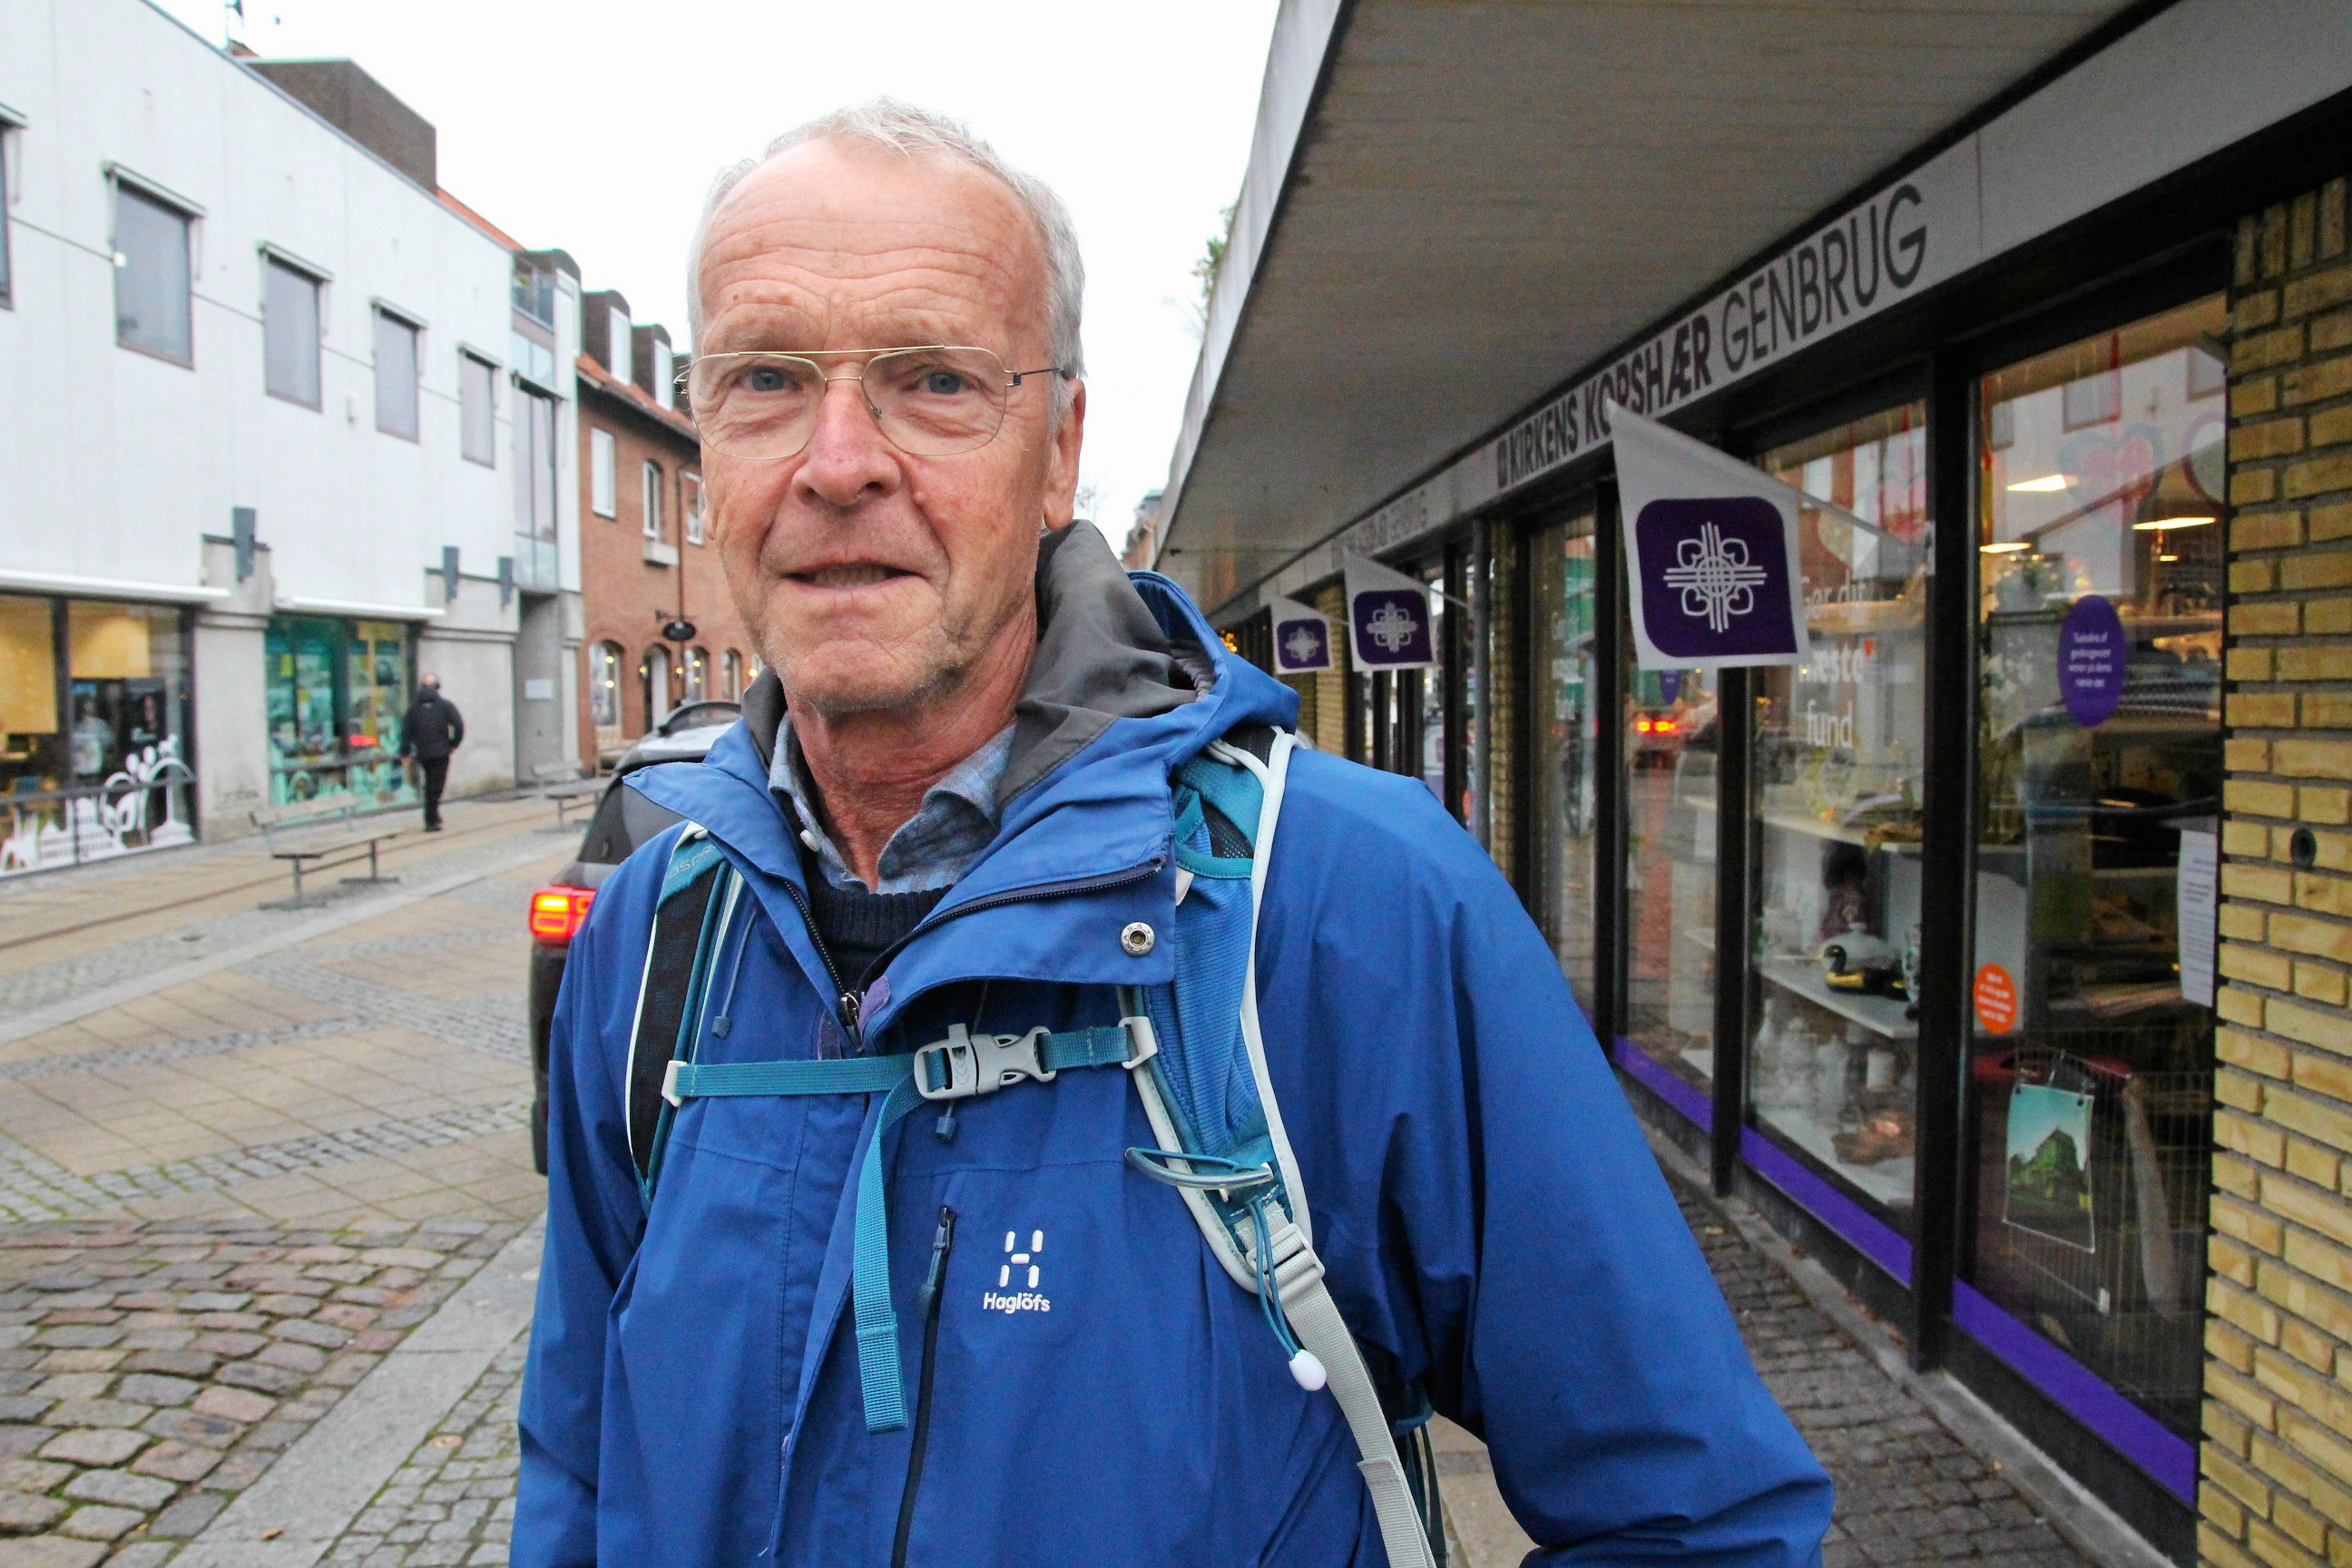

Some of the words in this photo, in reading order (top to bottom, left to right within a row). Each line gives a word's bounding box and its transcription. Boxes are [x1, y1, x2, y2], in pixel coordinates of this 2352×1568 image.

[1509, 394, 1579, 483] KIRKENS
[1585, 314, 1712, 445] KORSHÆR
[1721, 183, 1926, 373] GENBRUG
[1807, 698, 1853, 750] fund
[983, 1292, 1051, 1315] Haglöfs
